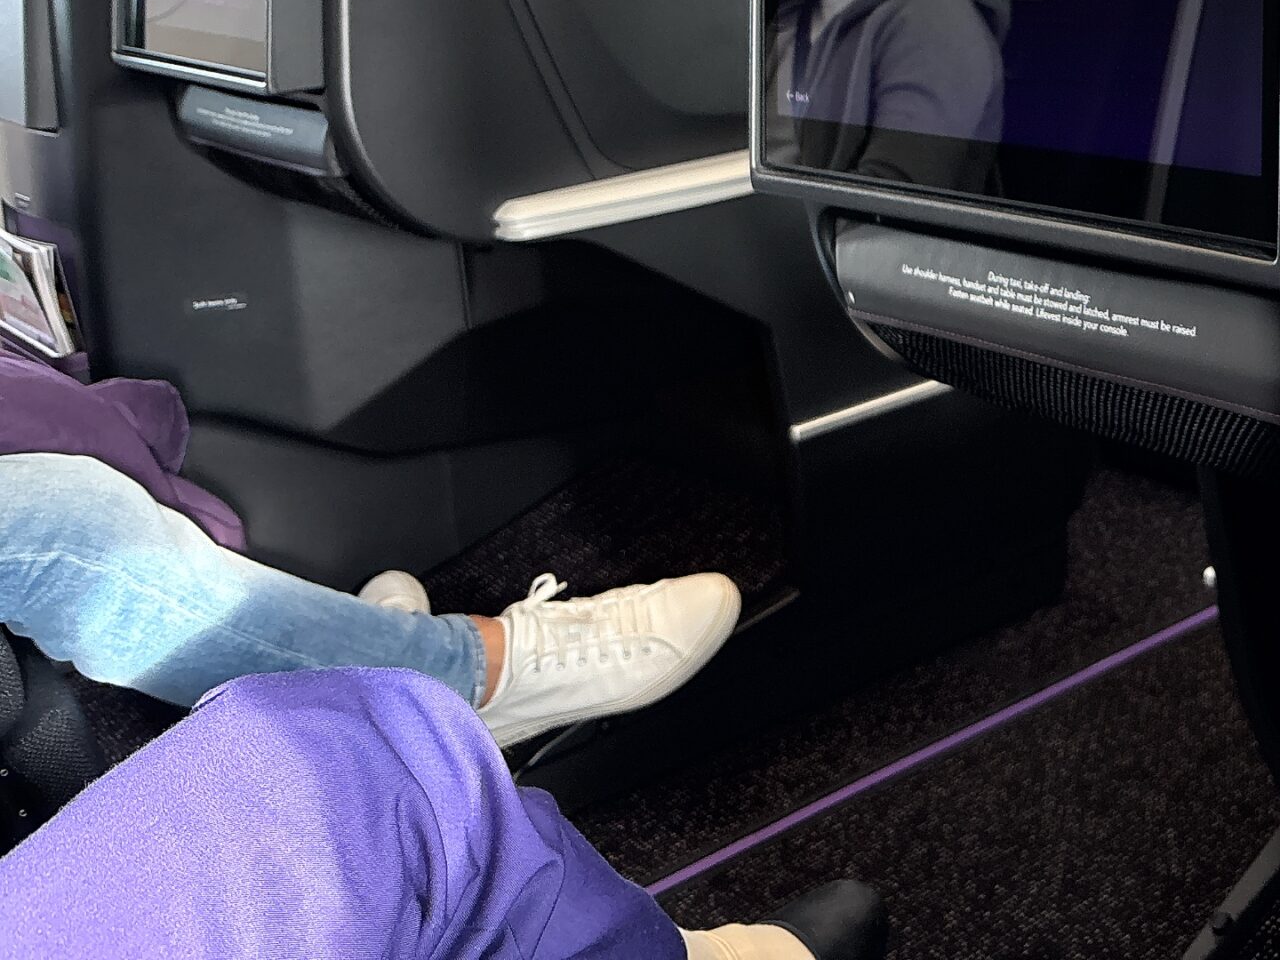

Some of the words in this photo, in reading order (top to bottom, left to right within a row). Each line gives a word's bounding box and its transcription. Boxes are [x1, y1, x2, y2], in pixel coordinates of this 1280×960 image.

[914, 265, 938, 280] shoulder
[987, 285, 1000, 295] and
[1000, 287, 1016, 299] table
[1016, 292, 1033, 303] must
[1033, 293, 1043, 305] be
[1043, 298, 1068, 311] stowed
[1068, 303, 1083, 314] and
[1111, 313, 1140, 326] armrest
[1140, 318, 1160, 330] must
[1160, 319, 1171, 332] be
[987, 270, 1009, 288] During
[1023, 280, 1050, 294] take-off
[1050, 287, 1064, 297] and
[948, 285, 969, 300] Fasten
[994, 298, 1011, 311] while
[1062, 314, 1082, 327] inside
[1082, 320, 1099, 331] your
[1099, 324, 1129, 337] console.
